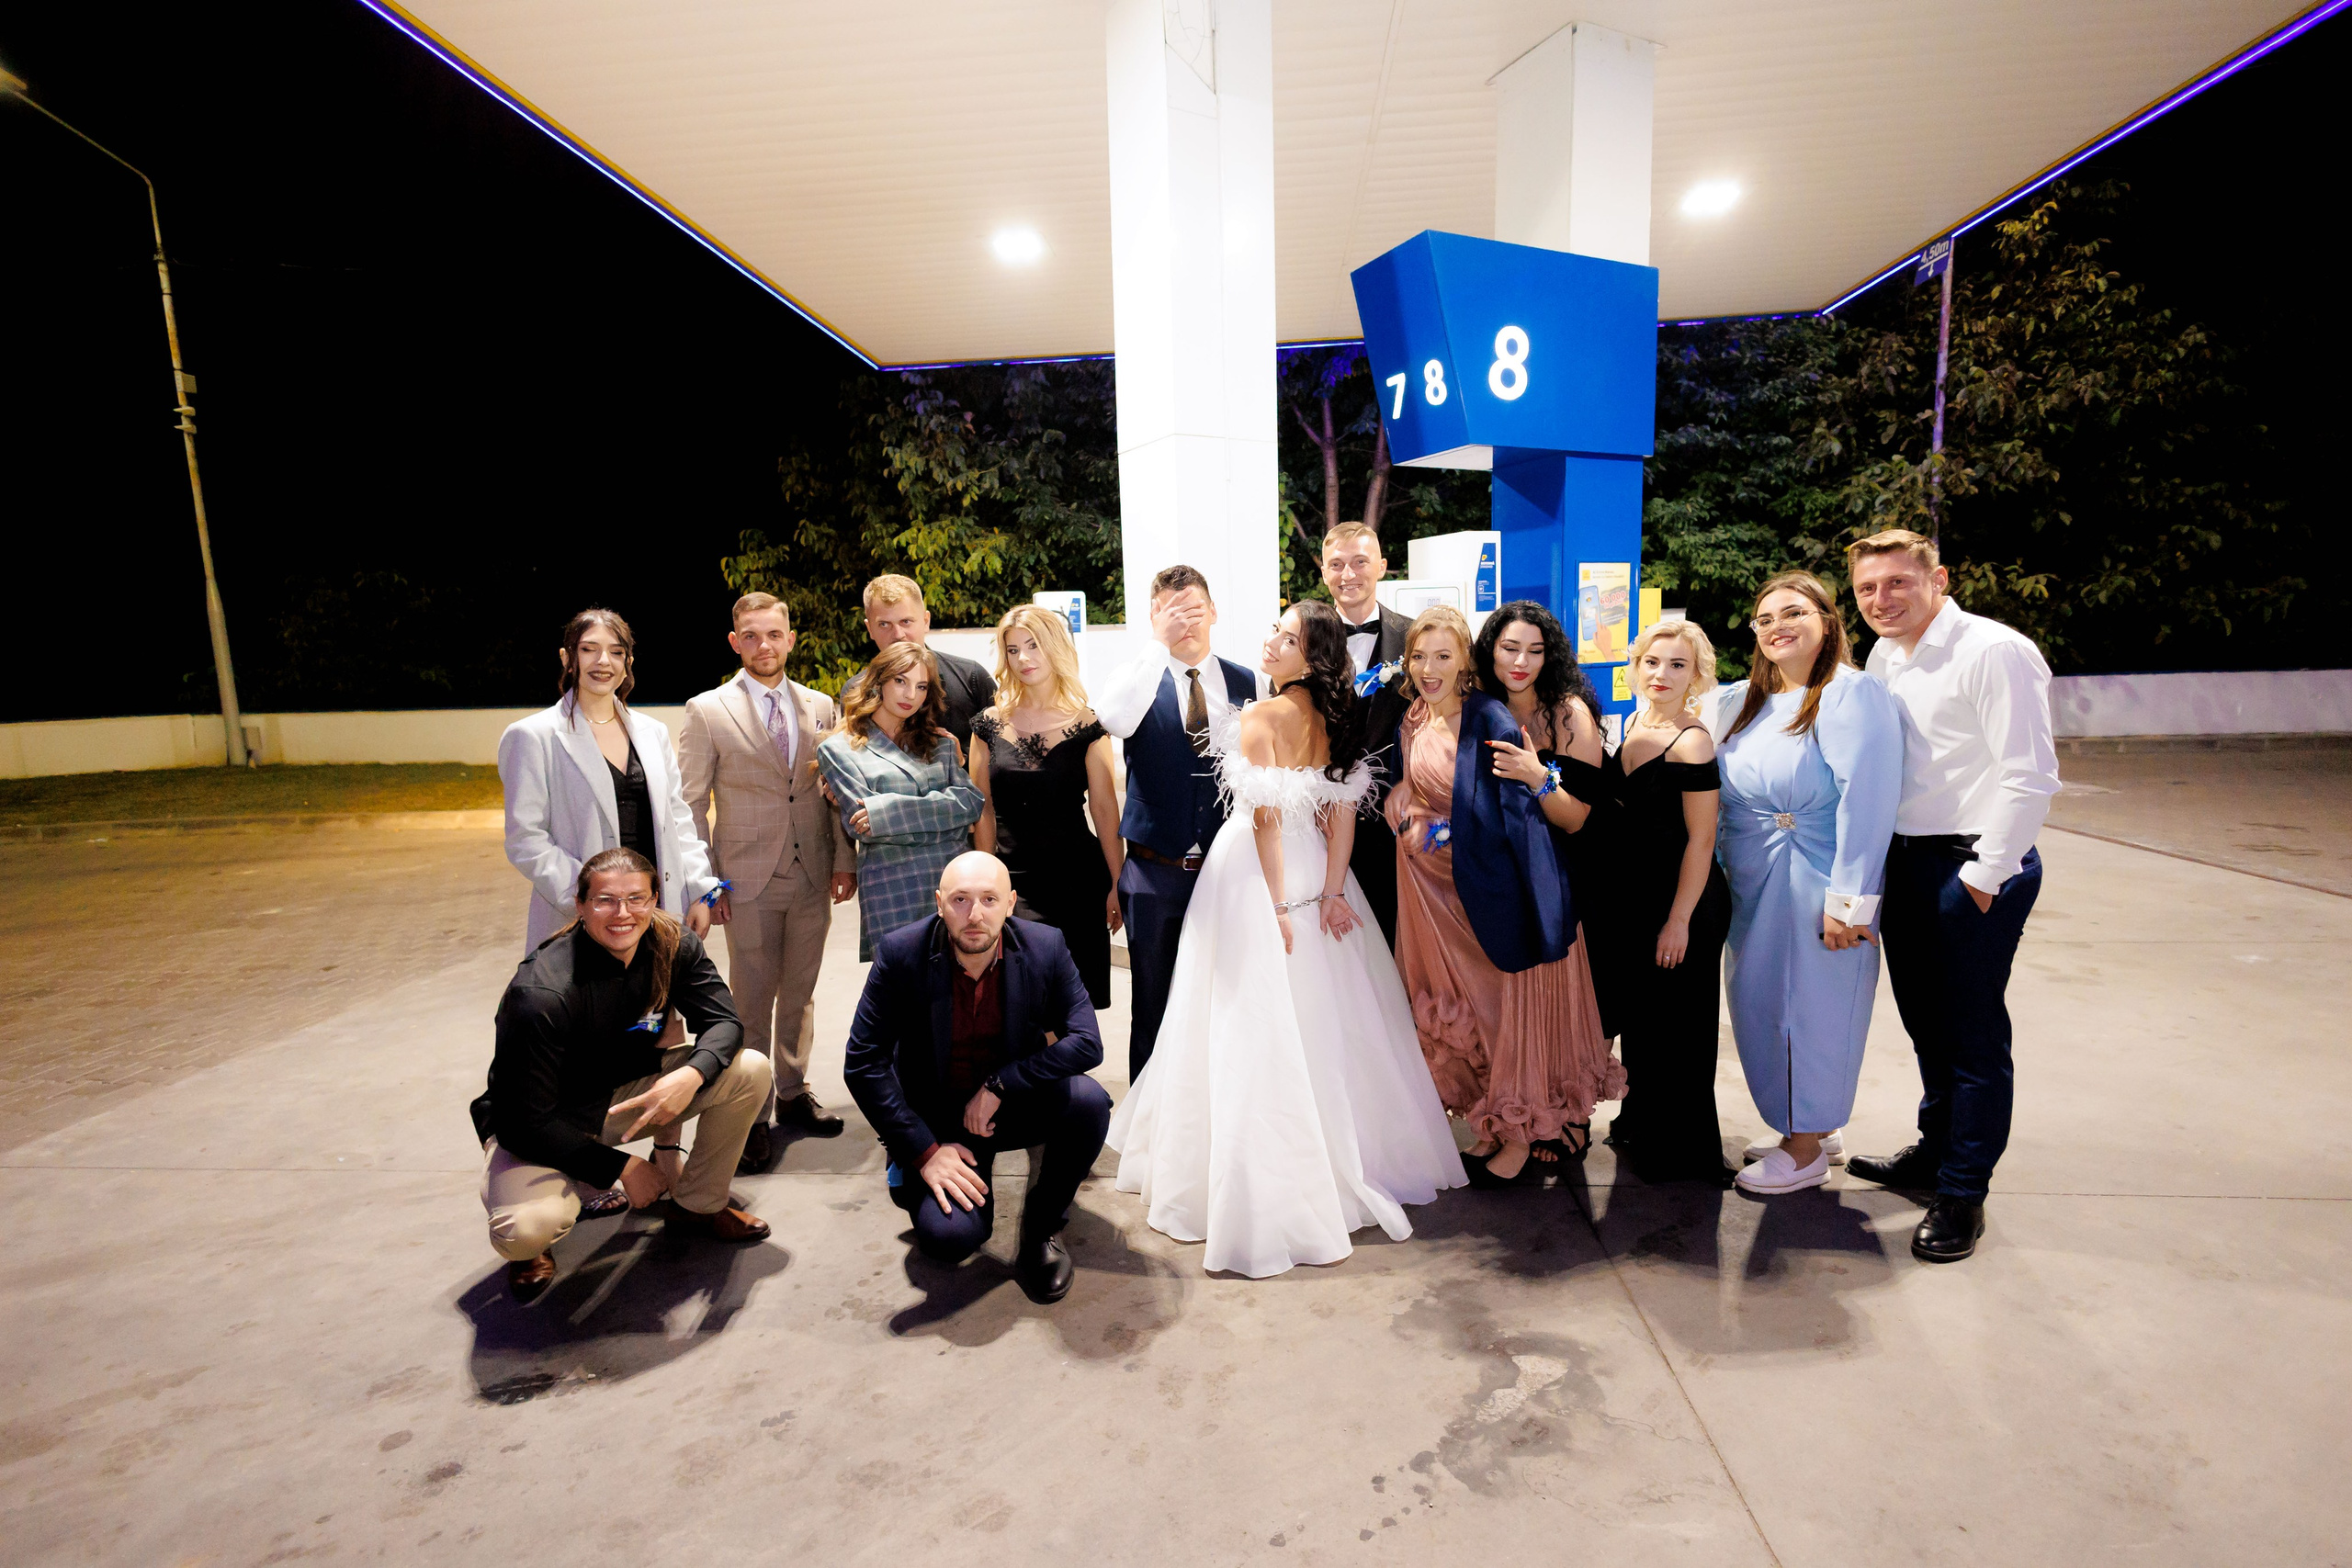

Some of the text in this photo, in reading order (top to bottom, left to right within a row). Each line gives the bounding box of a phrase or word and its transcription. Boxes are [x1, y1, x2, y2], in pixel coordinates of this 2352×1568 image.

[1920, 240, 1950, 264] 4,50m
[1385, 359, 1447, 420] 7 8
[1487, 325, 1530, 401] 8
